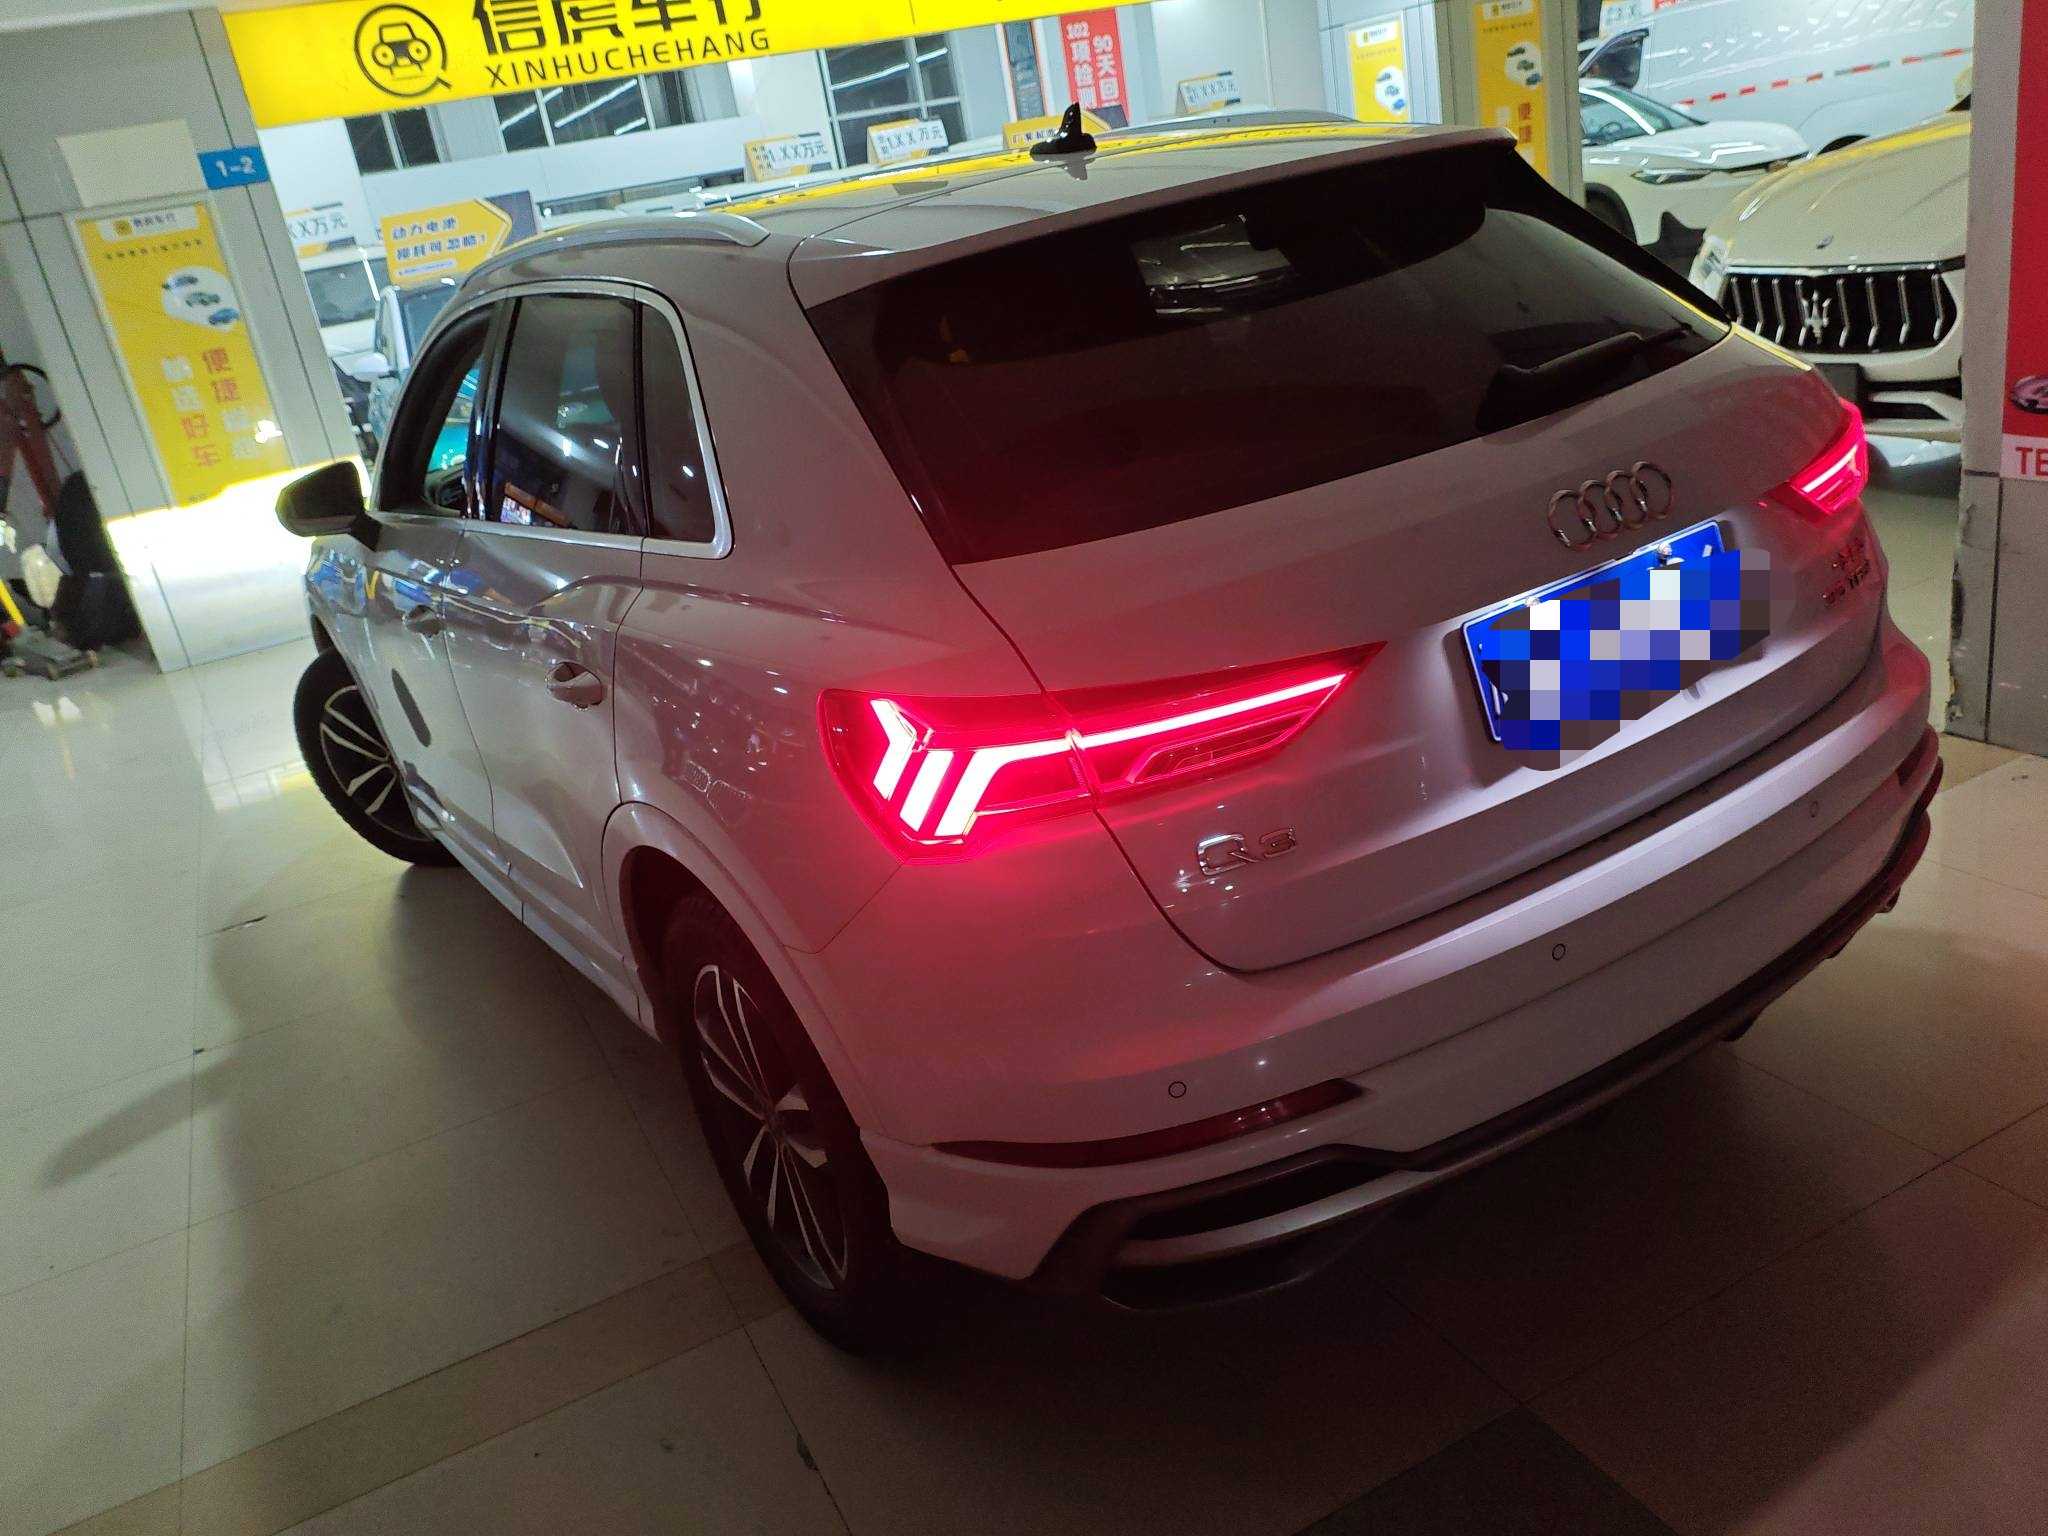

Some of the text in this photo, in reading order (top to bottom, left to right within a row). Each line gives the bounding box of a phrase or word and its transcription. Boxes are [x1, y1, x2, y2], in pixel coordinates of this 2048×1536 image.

[485, 28, 770, 88] XINHUCHEHANG
[217, 157, 257, 179] 1-2
[1197, 827, 1297, 876] Q3
